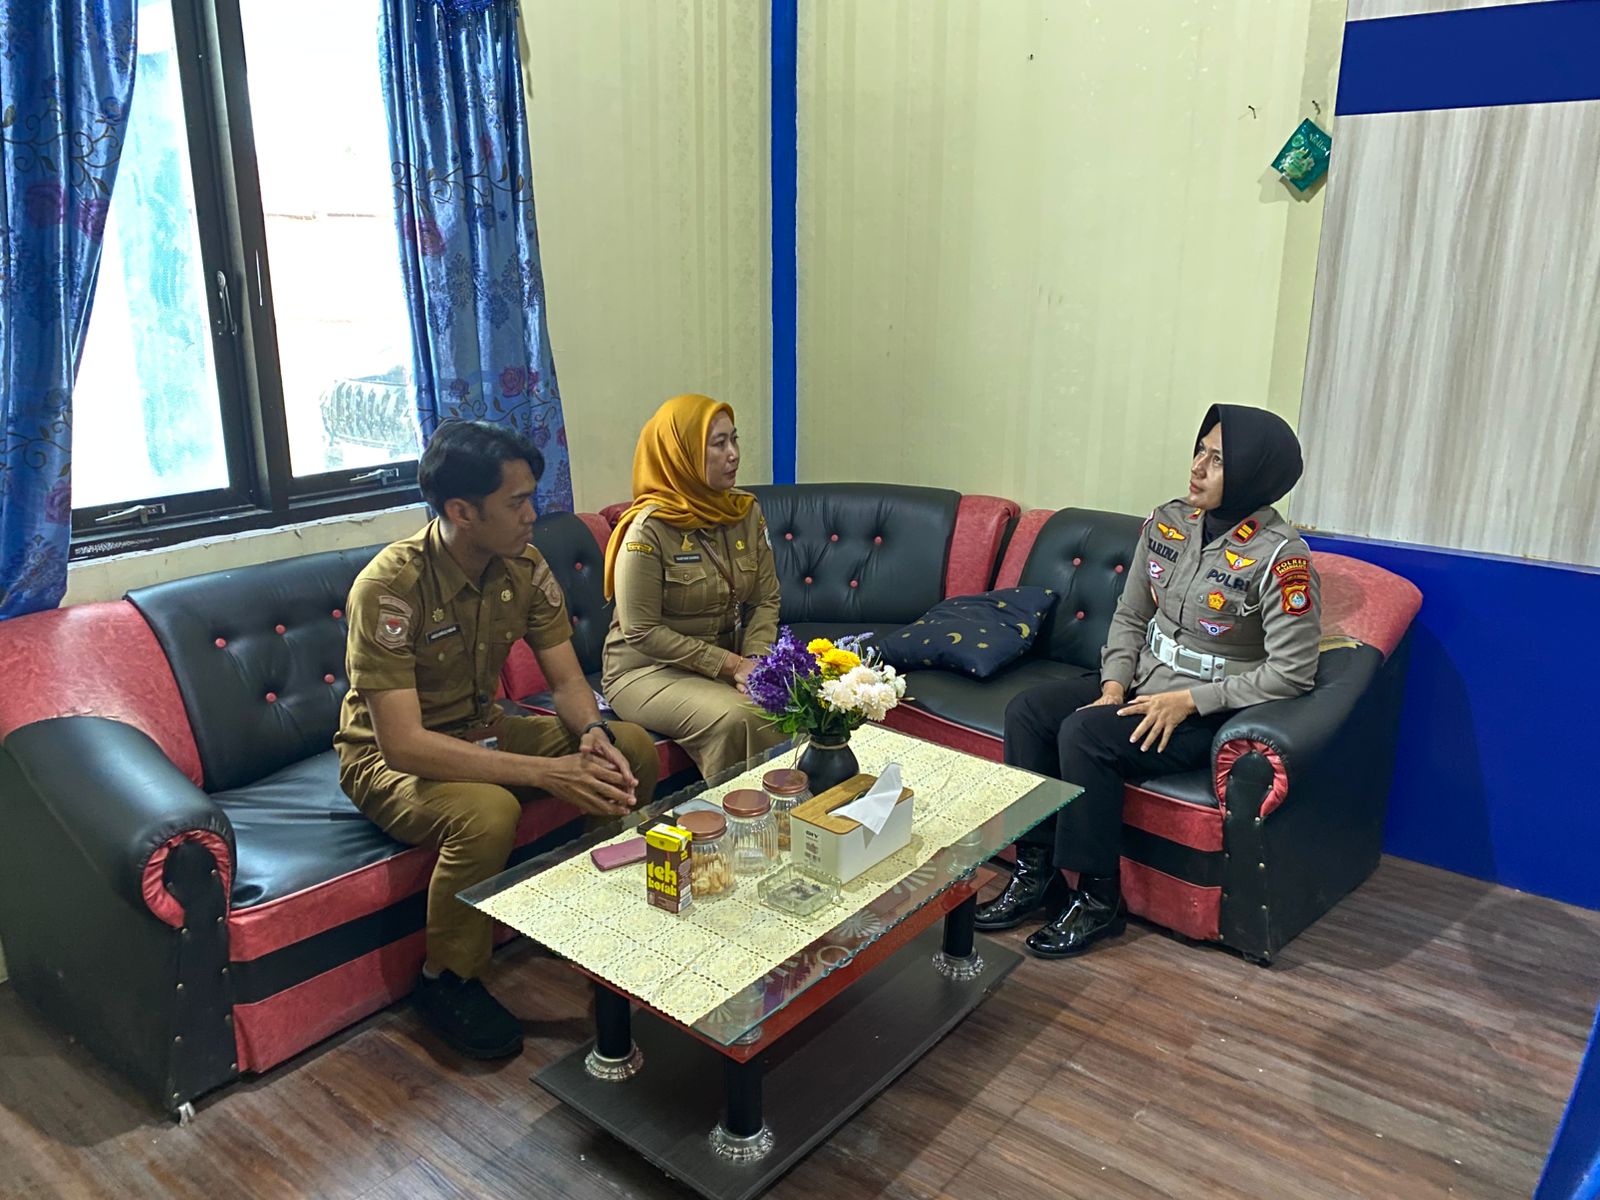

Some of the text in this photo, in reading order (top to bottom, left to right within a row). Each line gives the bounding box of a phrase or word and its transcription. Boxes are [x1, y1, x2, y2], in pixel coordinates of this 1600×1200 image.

[1276, 559, 1307, 571] POLRES
[1206, 568, 1250, 592] POLRI
[647, 861, 677, 886] teh
[648, 877, 677, 897] kotak
